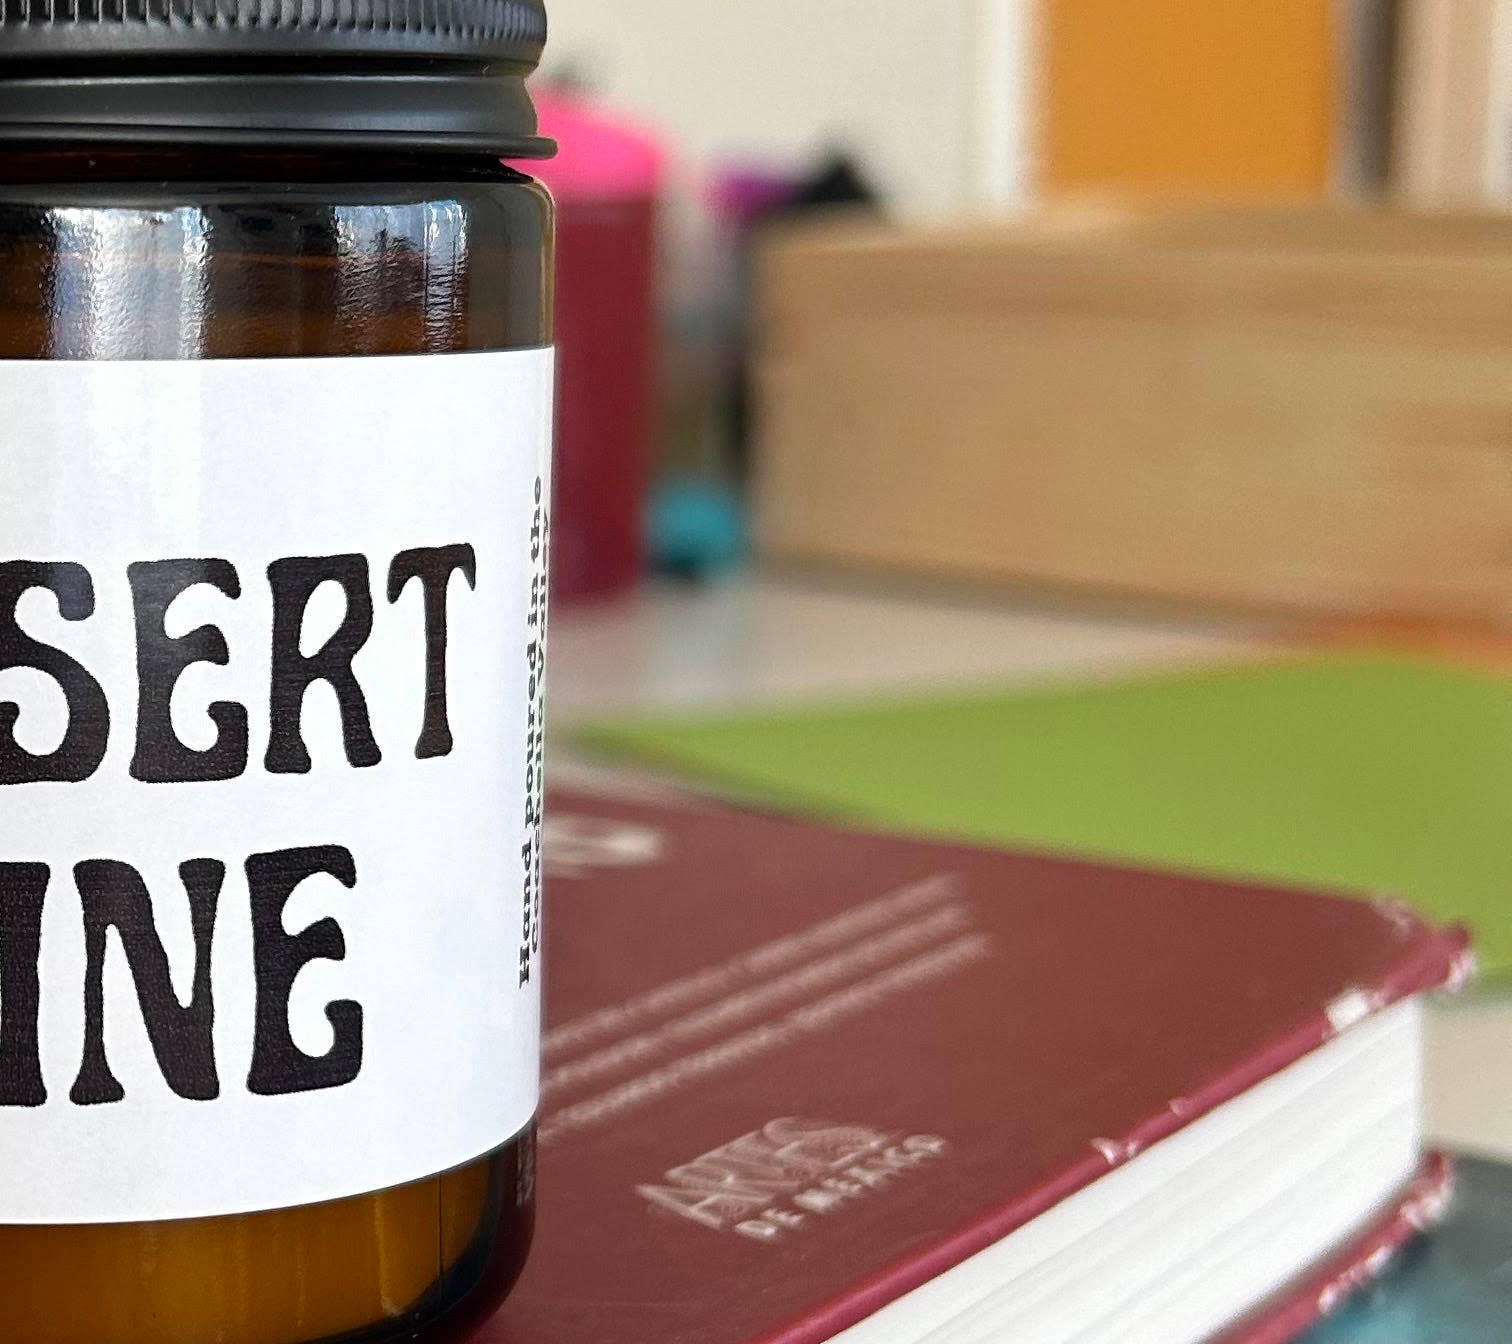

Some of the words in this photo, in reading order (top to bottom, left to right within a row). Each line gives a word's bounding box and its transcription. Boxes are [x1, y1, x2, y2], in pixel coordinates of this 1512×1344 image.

[531, 475, 541, 563] the
[528, 572, 538, 626] in
[525, 639, 536, 829] poured
[519, 838, 532, 989] Hand
